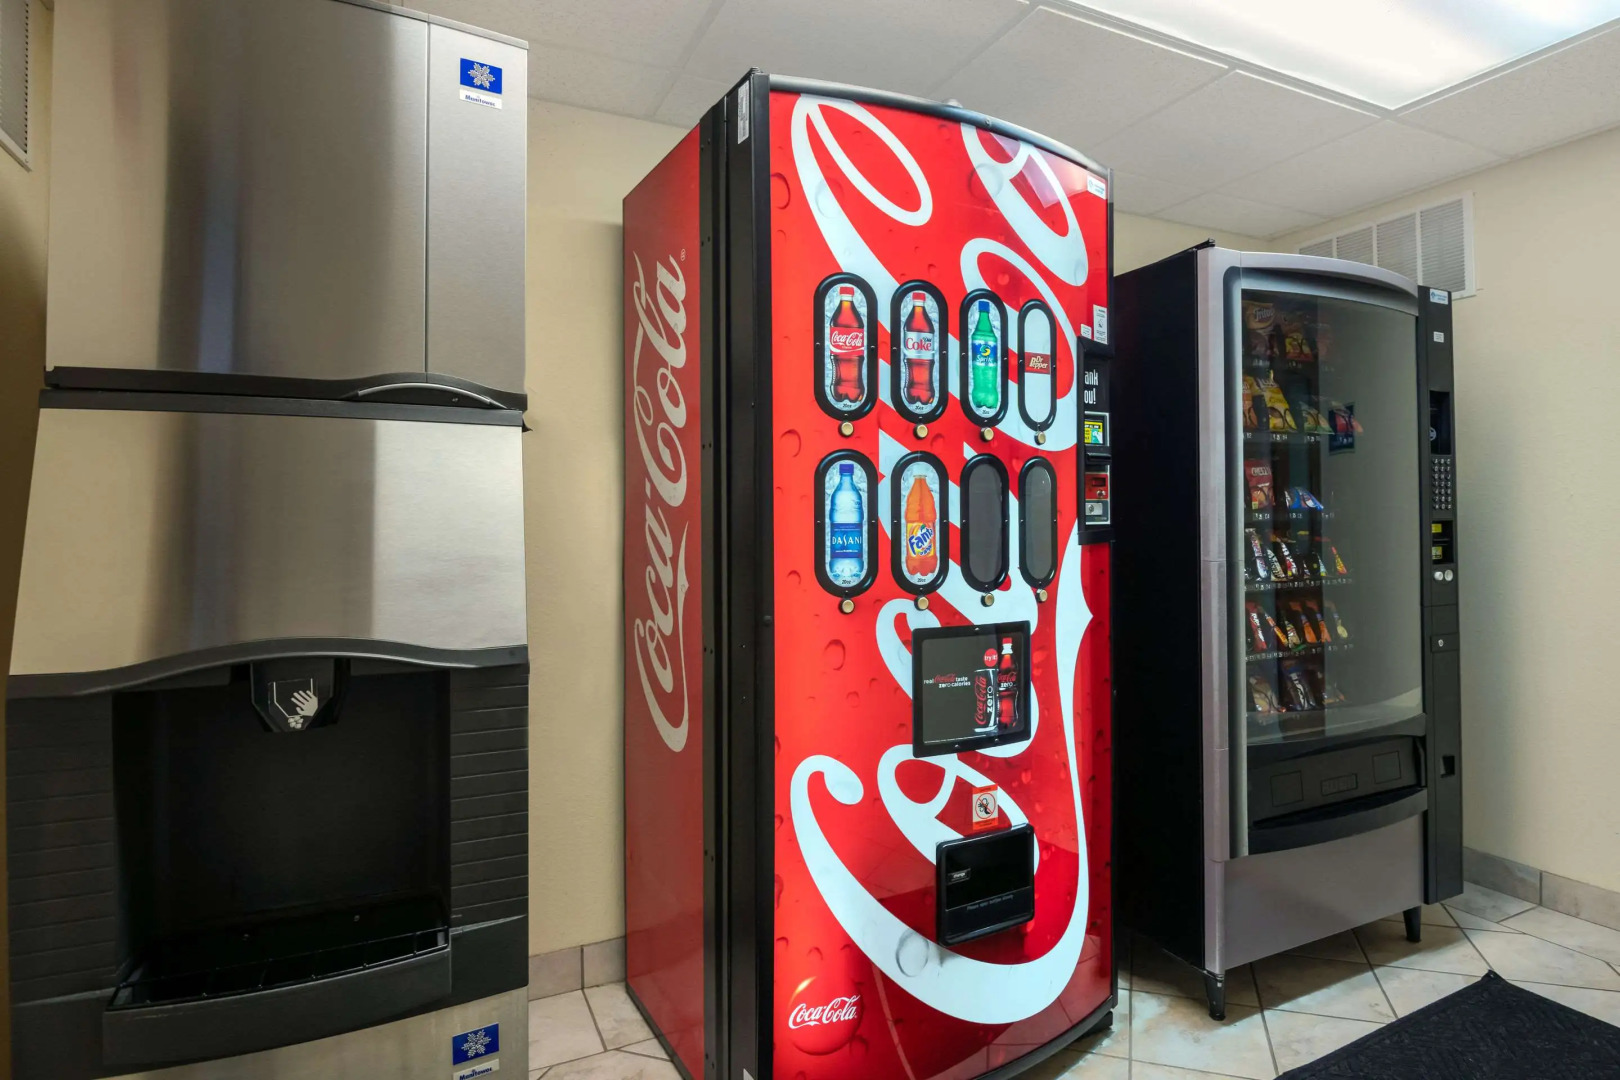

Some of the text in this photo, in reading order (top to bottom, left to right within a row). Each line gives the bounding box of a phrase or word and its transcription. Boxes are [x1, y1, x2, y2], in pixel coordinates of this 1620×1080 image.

[831, 330, 863, 346] Coca-Cola
[906, 337, 932, 351] Coke
[1029, 357, 1049, 370] Pepper
[1084, 369, 1099, 386] ank
[1084, 388, 1096, 405] ou!
[633, 250, 689, 752] Coca-Cola
[832, 535, 862, 546] DASANI
[986, 685, 994, 714] zero
[788, 995, 861, 1029] Coca-Cola
